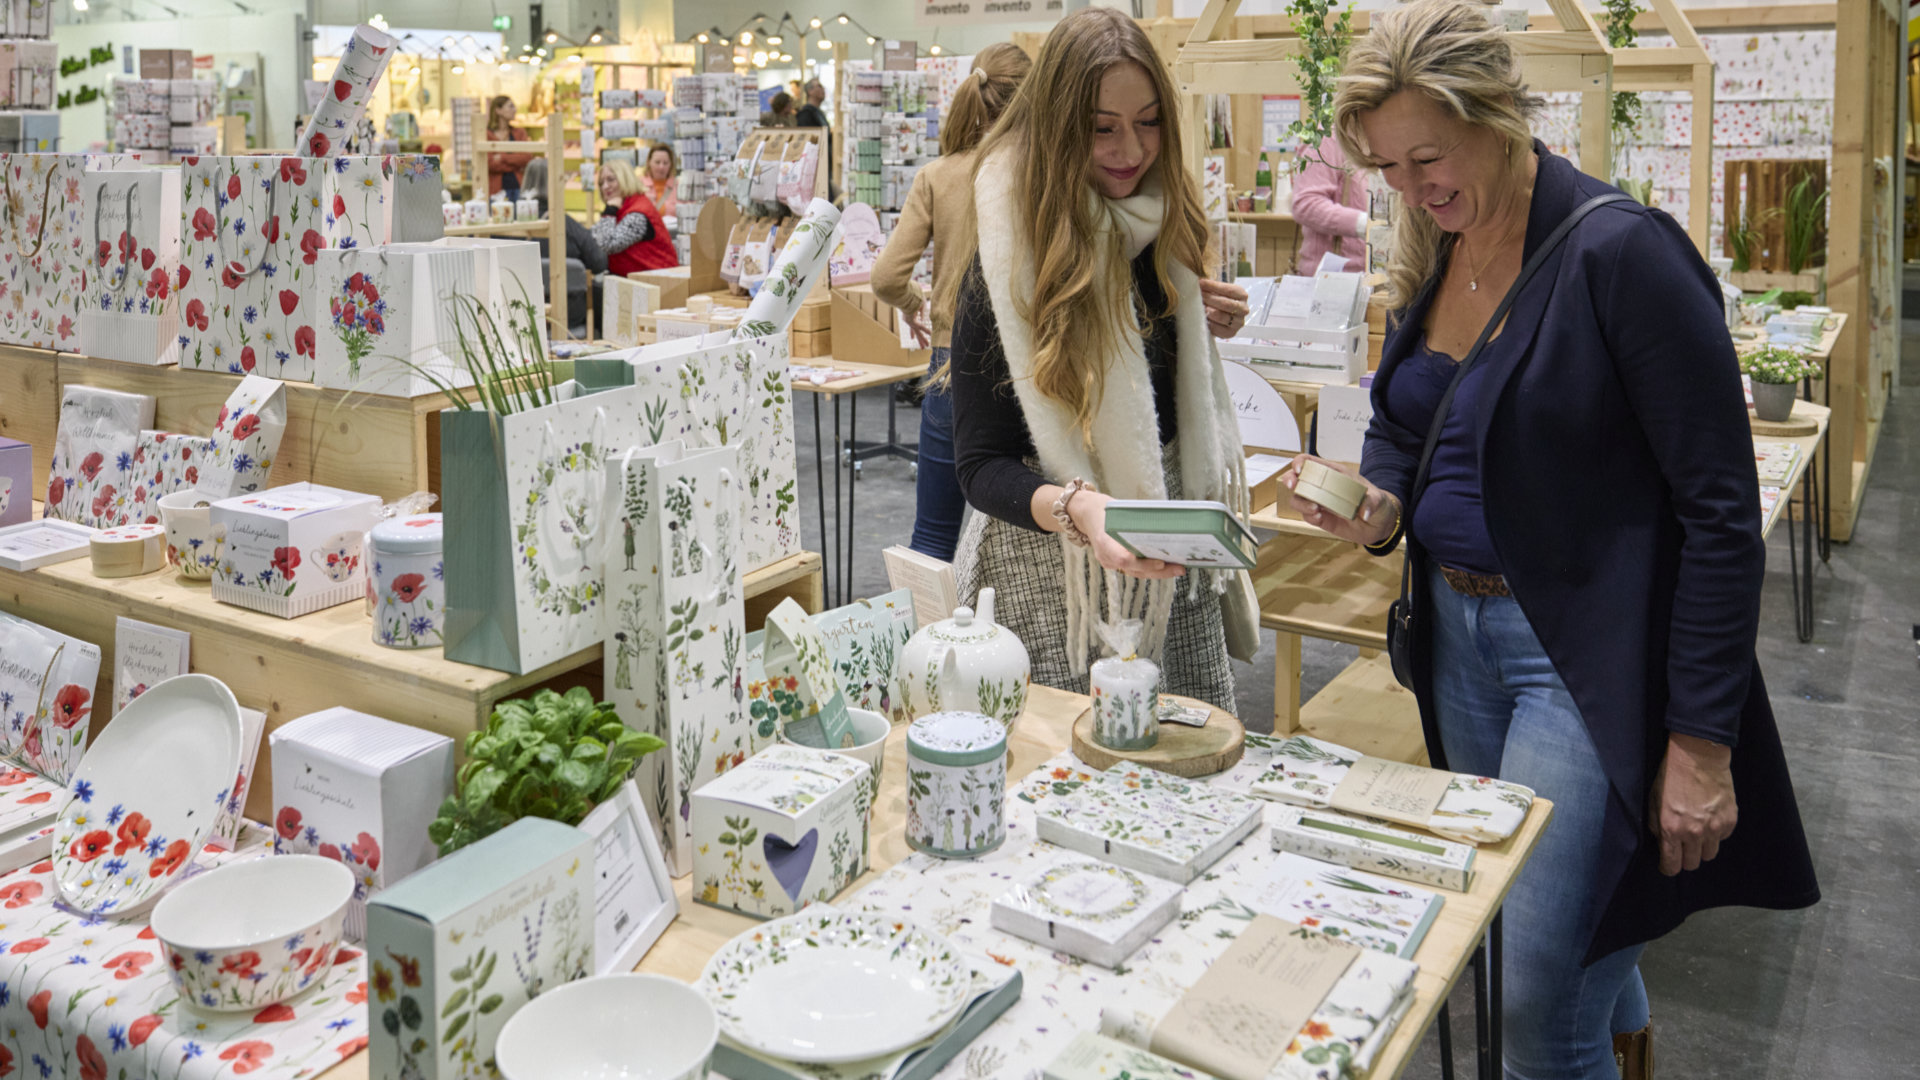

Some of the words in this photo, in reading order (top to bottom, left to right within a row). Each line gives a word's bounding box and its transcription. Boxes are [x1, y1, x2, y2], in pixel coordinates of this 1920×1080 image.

[925, 3, 970, 15] invento
[984, 1, 1031, 13] invento
[232, 519, 280, 541] Lieblingstasse
[822, 616, 875, 650] rgarten
